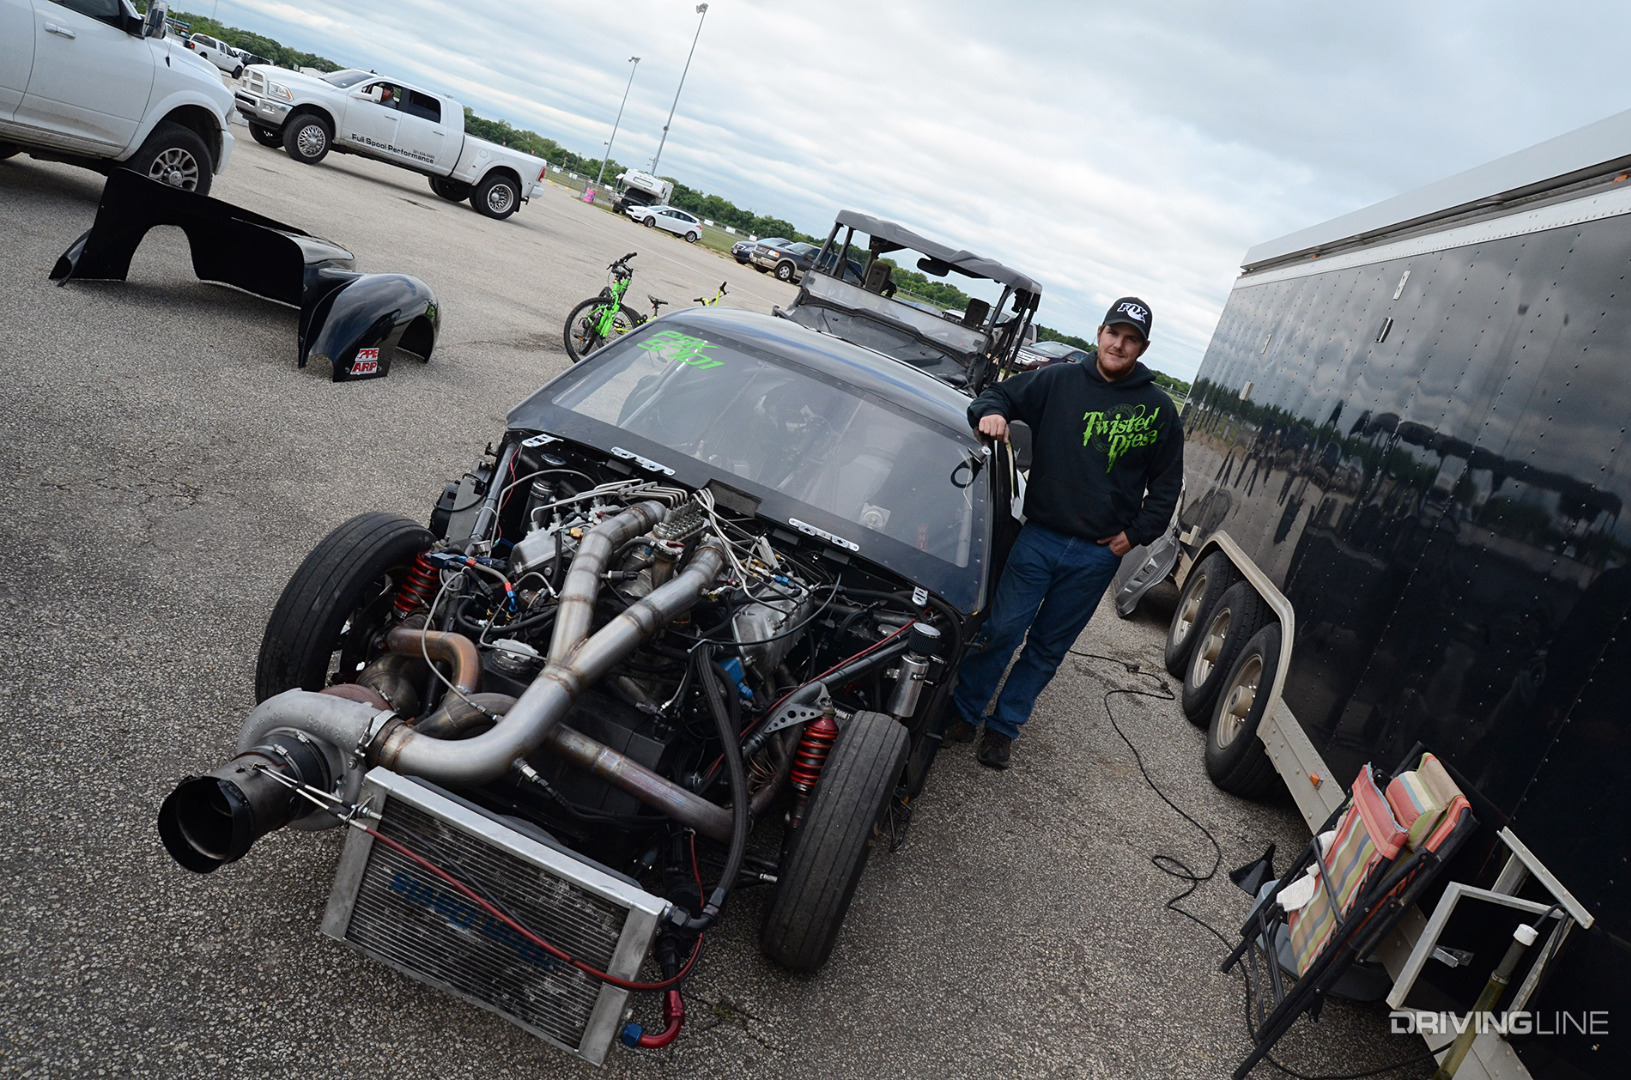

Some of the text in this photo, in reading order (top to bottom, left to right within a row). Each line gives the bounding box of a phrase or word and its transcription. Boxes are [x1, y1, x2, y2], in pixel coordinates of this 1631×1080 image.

[351, 133, 364, 143] Full
[365, 137, 387, 149] Spool
[388, 144, 434, 164] Performance
[1117, 302, 1148, 321] FOX
[351, 361, 378, 373] ARP
[1083, 404, 1160, 447] Twisted
